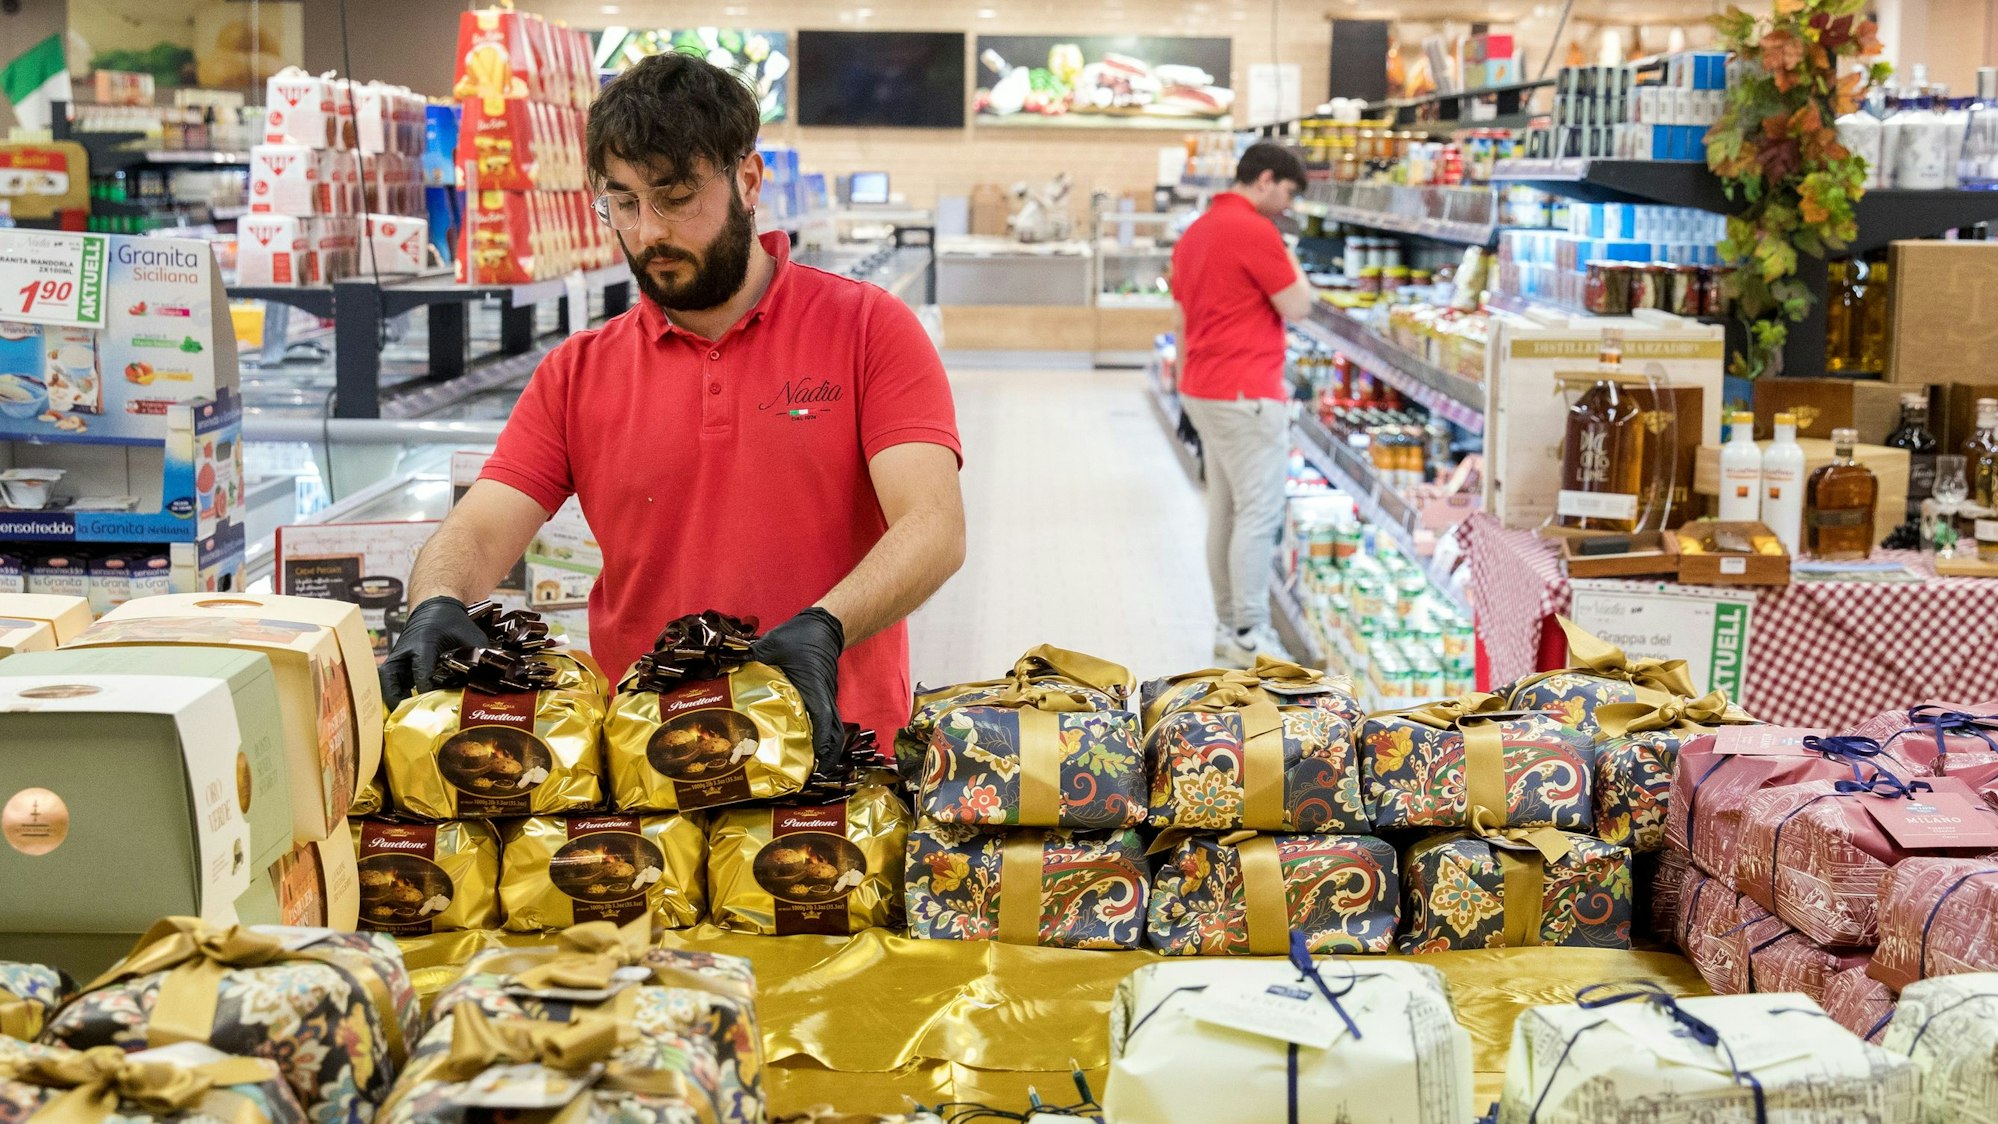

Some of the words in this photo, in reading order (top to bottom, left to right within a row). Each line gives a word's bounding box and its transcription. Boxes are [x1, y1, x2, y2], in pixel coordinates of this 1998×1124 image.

[0, 256, 28, 264] RANITA
[30, 259, 74, 267] MANDORLA
[118, 244, 198, 268] Granita
[81, 241, 101, 319] AKTUELL
[133, 267, 198, 284] Siciliana
[758, 377, 843, 410] Nadia
[0, 521, 74, 535] ensofreddo
[79, 523, 88, 534] la
[91, 519, 144, 535] Granita
[34, 577, 42, 585] la
[43, 576, 82, 586] Granita
[92, 579, 99, 587] la
[101, 577, 129, 587] Granit
[145, 579, 169, 588] Gran
[1597, 630, 1646, 646] Grappa
[1651, 633, 1671, 645] del
[1715, 609, 1742, 700] KTUELL
[667, 695, 723, 712] Panettone
[468, 709, 527, 722] Panettone
[208, 799, 232, 832] VERDE
[1905, 816, 1962, 824] MILANO
[575, 820, 632, 831] Panettone
[781, 818, 838, 828] Panettone
[368, 837, 427, 849] Panettone
